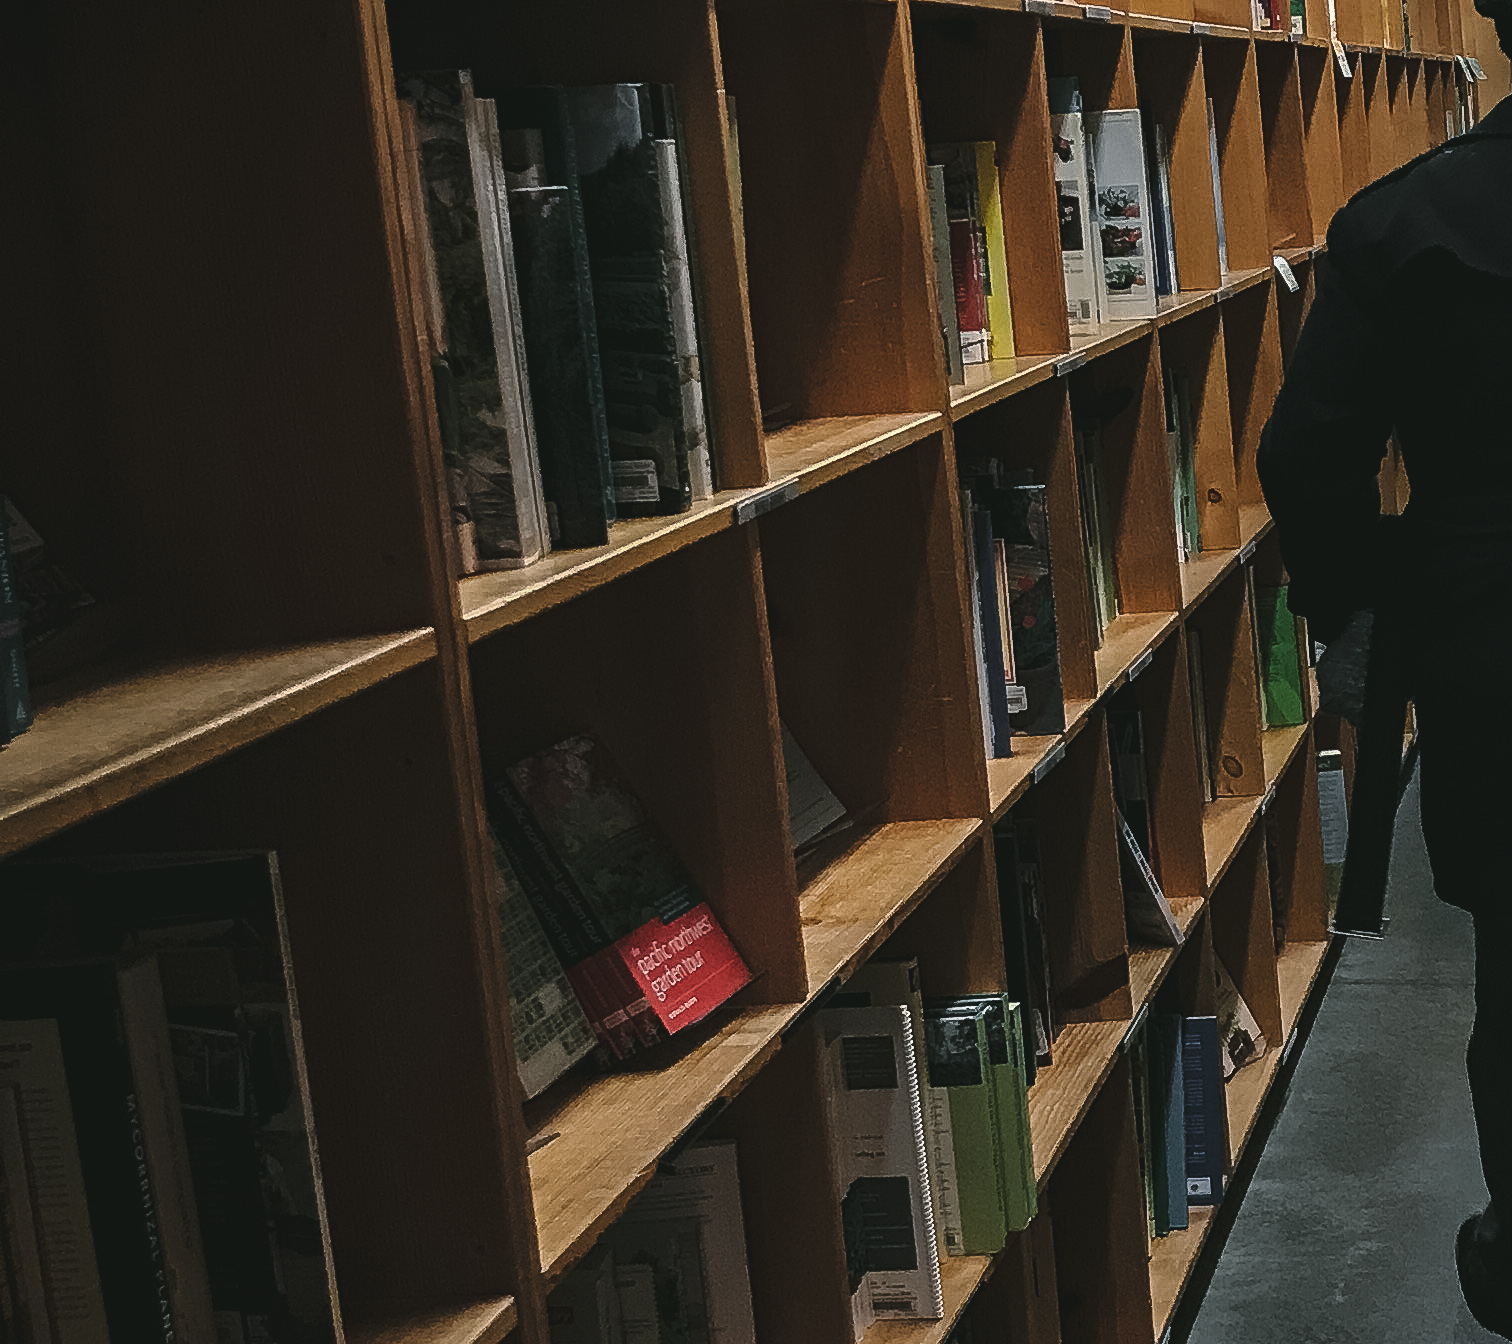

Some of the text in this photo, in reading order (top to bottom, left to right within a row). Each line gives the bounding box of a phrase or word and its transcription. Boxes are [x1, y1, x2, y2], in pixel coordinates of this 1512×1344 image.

[498, 786, 530, 824] pacific
[554, 880, 588, 921] garden
[581, 920, 603, 945] tour
[533, 893, 565, 934] garden
[558, 933, 579, 959] tour
[638, 915, 714, 980] pacific northwest
[652, 951, 704, 1001] garden tour
[126, 1094, 160, 1262] MYCORRHIZAL
